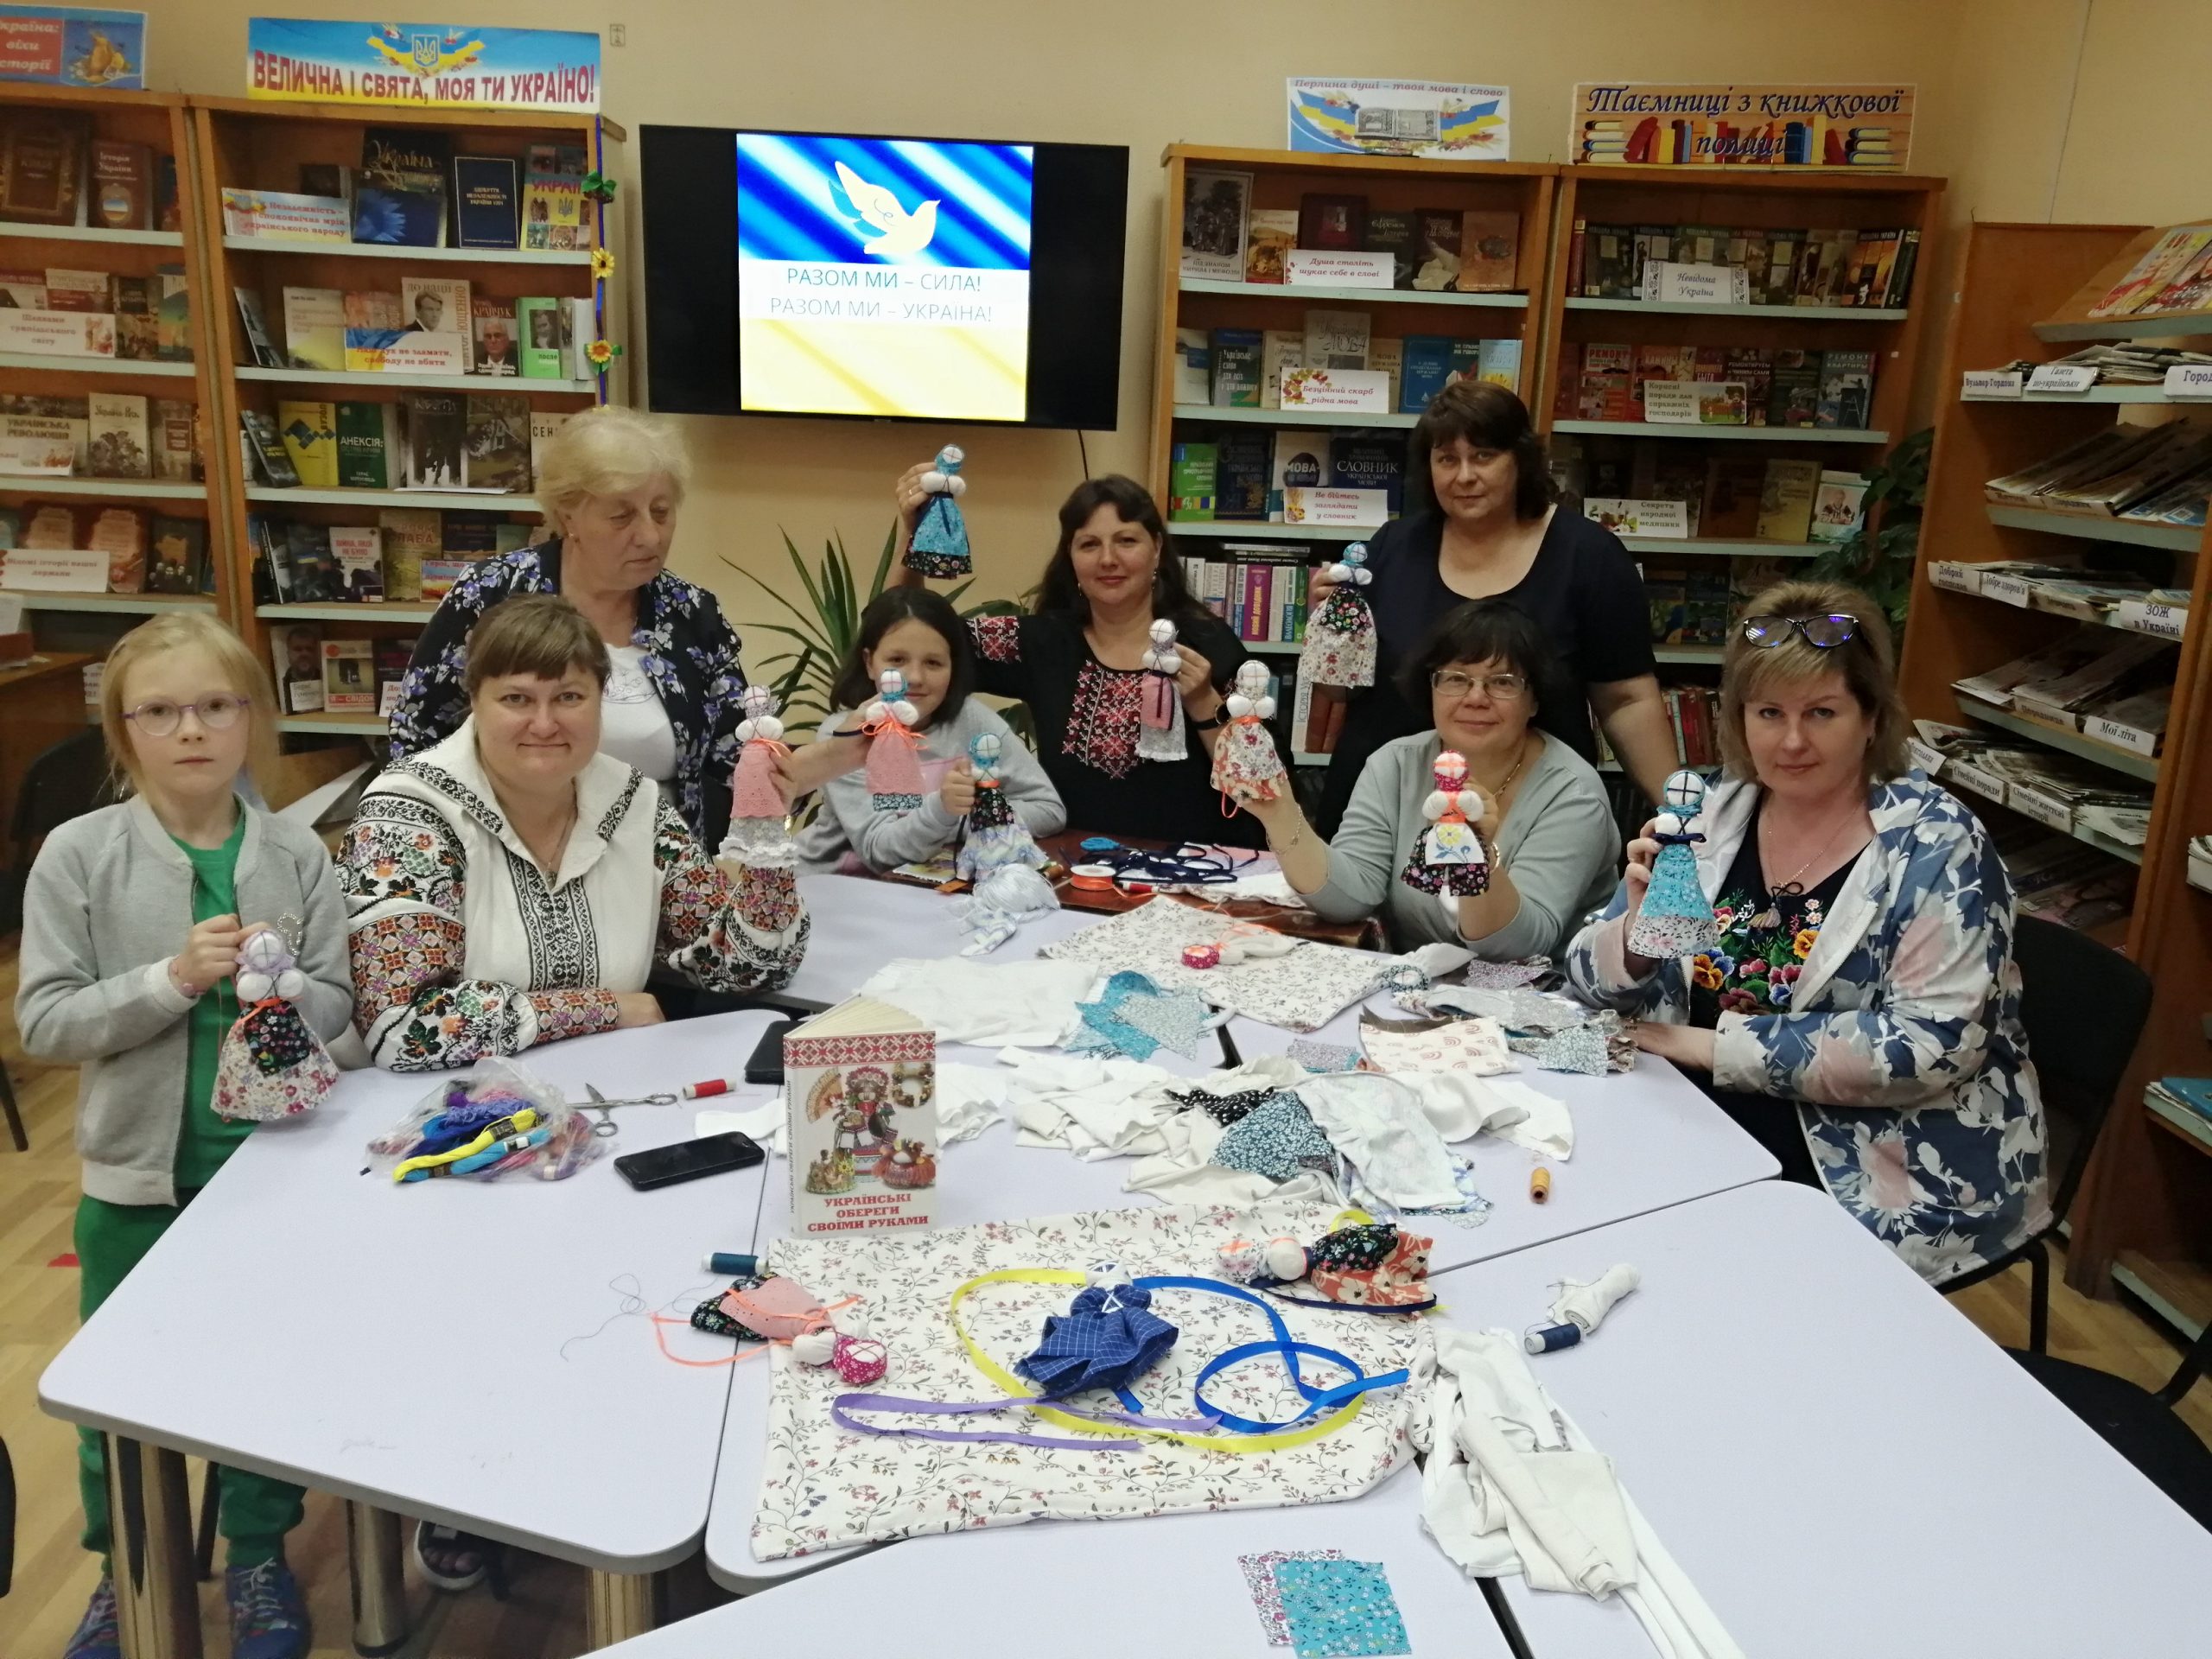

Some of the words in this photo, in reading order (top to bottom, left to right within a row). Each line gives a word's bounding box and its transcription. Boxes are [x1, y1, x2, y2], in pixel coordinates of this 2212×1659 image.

[0, 19, 60, 34] країна:
[6, 39, 40, 51] віхи
[0, 57, 52, 73] сторії
[254, 50, 344, 97] ВЕЛИЧНА
[350, 72, 355, 96] І
[361, 73, 429, 105] СВЯТА,
[435, 76, 475, 101] МОЯ
[482, 77, 505, 102] ТИ
[511, 62, 594, 104] УКРАЇНО!
[1294, 79, 1347, 89] Перлина
[1351, 81, 1379, 92] душі
[1429, 86, 1459, 94] мова
[1471, 87, 1503, 97] слово
[1586, 85, 1732, 118] Таємниці
[1738, 92, 1751, 112] з
[1761, 89, 1904, 119] книжкової
[1696, 135, 1784, 159] полиці
[99, 152, 130, 162] Історія
[270, 201, 336, 214] Незалежність
[257, 213, 320, 225] споконвічна
[323, 218, 346, 227] мрія
[245, 222, 309, 234] українського
[312, 228, 346, 238] народу
[1309, 257, 1333, 268] Душа
[1337, 259, 1374, 268] століть
[1299, 269, 1328, 277] шукає
[1330, 268, 1348, 276] себе
[1358, 270, 1380, 278] слові
[1677, 272, 1716, 283] Невідома
[787, 268, 858, 287] РАЗОМ
[865, 271, 898, 289] МИ
[920, 273, 982, 292] СИЛА!
[1678, 285, 1714, 296] Україна
[455, 285, 467, 332] ЮЩЕНКО
[474, 307, 512, 319] КРАВЧУК
[771, 298, 841, 315] РАЗОМ
[848, 301, 880, 317] МИ
[903, 302, 992, 323] УКРАЇНА!
[413, 349, 453, 359] зламати,
[1588, 348, 1628, 359] РЕМОНТ
[2050, 366, 2073, 376] Газета
[2032, 378, 2081, 389] по-українськи
[1303, 385, 1345, 397] Безцінний
[1348, 386, 1374, 397] скарб
[1311, 397, 1334, 406] рідна
[1649, 401, 1690, 410] справжніх
[1649, 410, 1692, 419] господарів
[7, 418, 71, 430] УКРАЇНСЬКА
[340, 435, 385, 448] АНЕКСІЯ:
[1337, 461, 1399, 474] СЛОВНИК
[1327, 491, 1360, 500] бійтесь
[1314, 502, 1358, 511] заглядати
[1641, 501, 1675, 510] Секрети
[1639, 510, 1676, 518] народної
[1938, 565, 1963, 579] Добрий
[2145, 603, 2171, 619] ЗОЖ
[1251, 615, 1260, 636] НОВИЙ
[2134, 620, 2141, 629] в
[2142, 617, 2180, 636] Україні
[346, 694, 375, 704] СВІДОК
[1298, 691, 1307, 723] ІСТОРІЯ
[2101, 721, 2117, 734] Мої
[2119, 728, 2137, 743] літа
[1954, 766, 1976, 785] Сімейні
[1976, 779, 2000, 797] поради
[2012, 786, 2038, 806] Сімейні
[824, 1193, 912, 1208] УКРАЇНСЬКІ
[836, 1205, 899, 1219] ОБЕРЕГИ
[807, 1218, 865, 1233] СВОЇМИ
[868, 1215, 929, 1229] РУКАМИ
